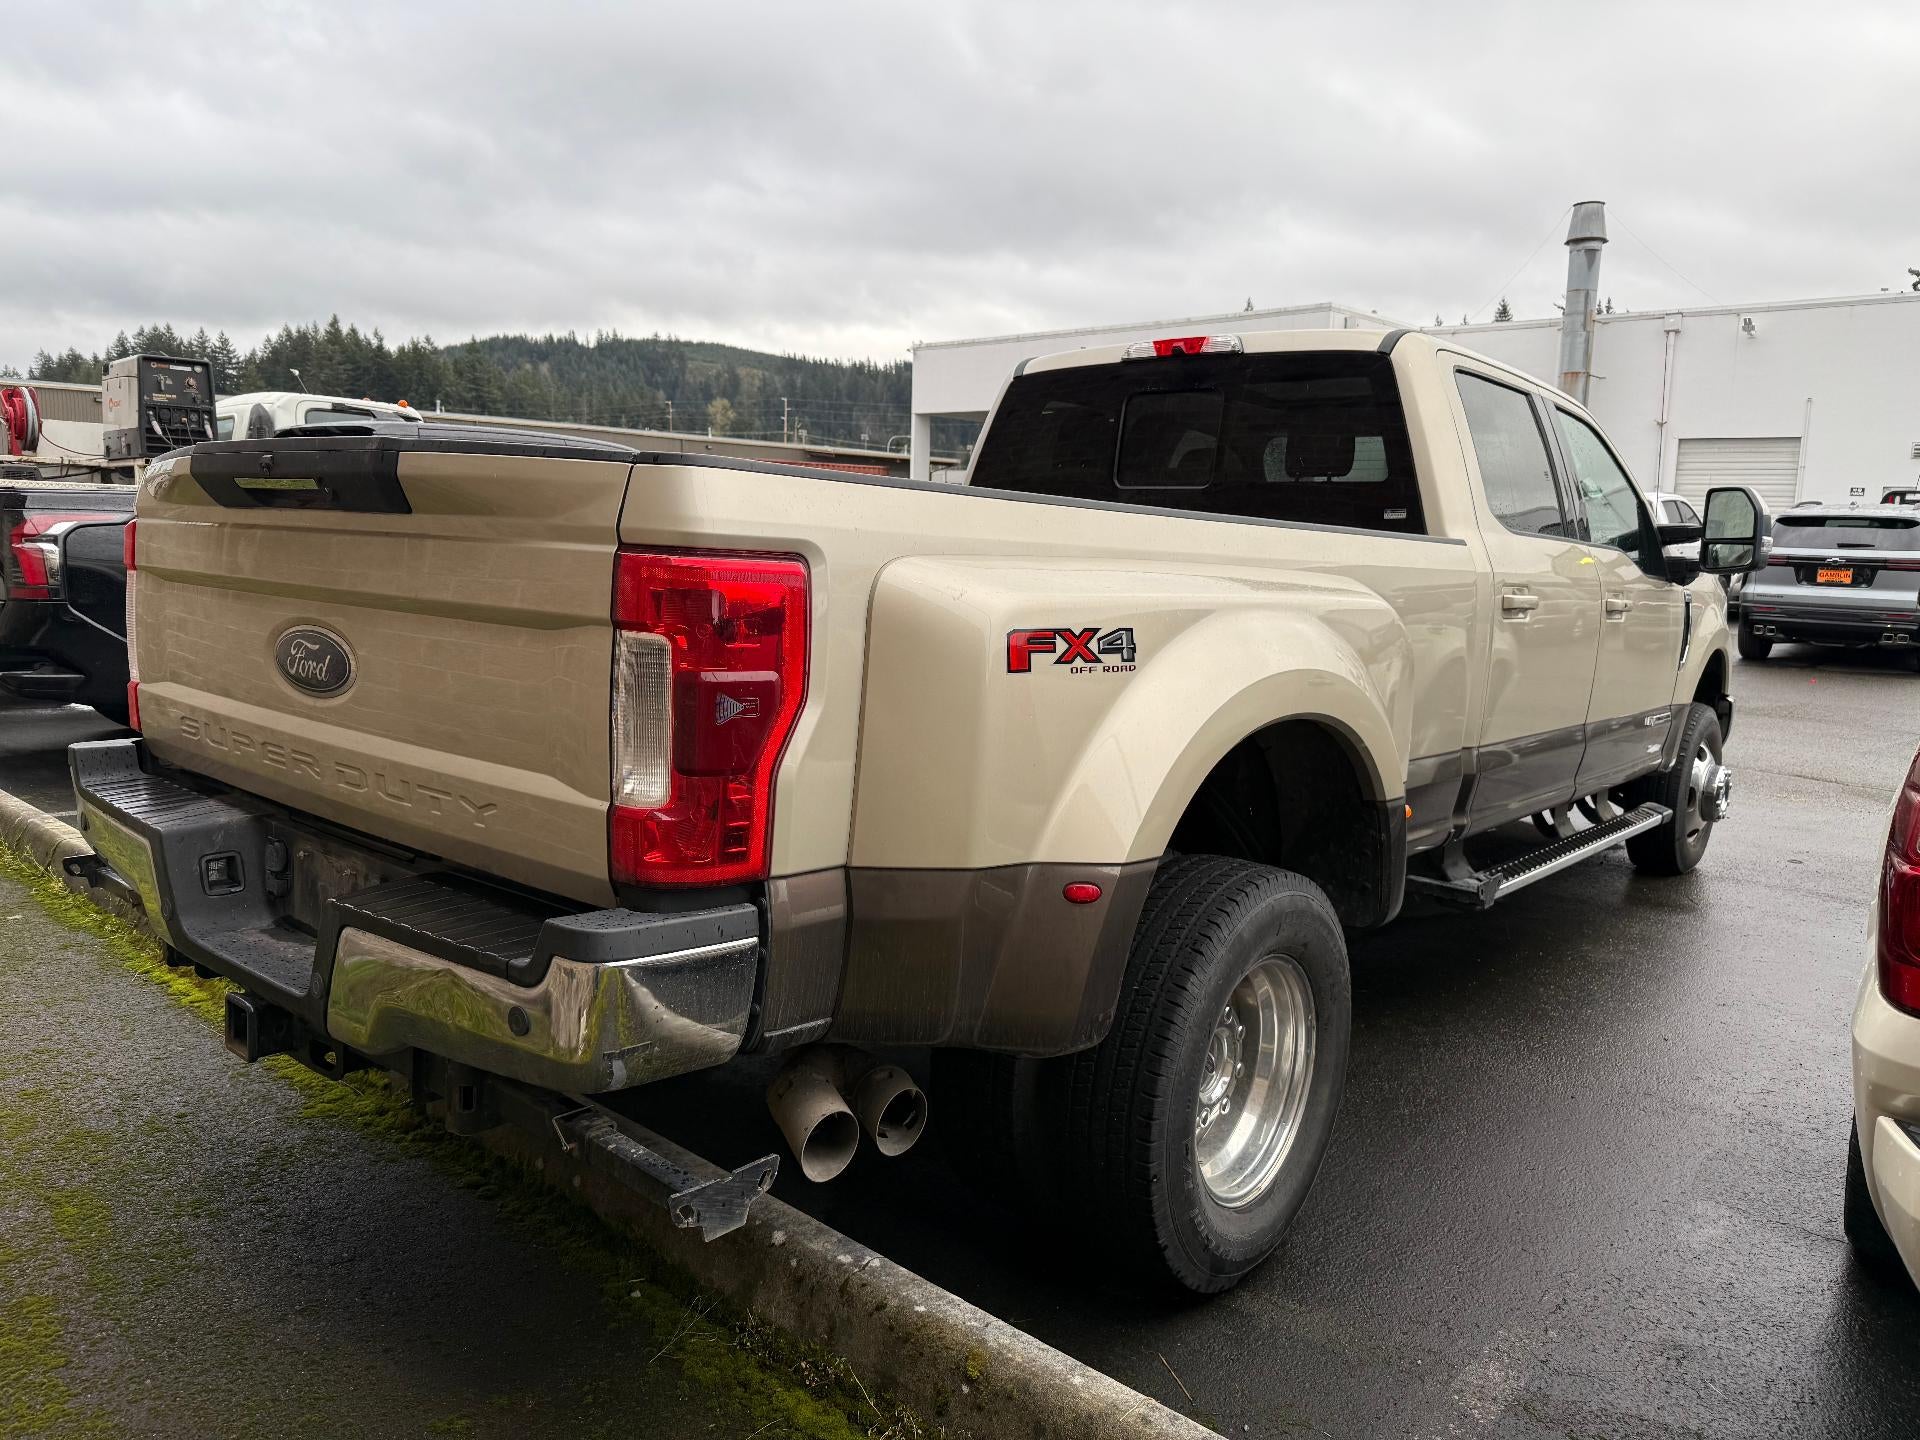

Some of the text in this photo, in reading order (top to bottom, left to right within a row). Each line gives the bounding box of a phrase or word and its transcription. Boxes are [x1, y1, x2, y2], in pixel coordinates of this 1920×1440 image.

[287, 638, 331, 682] Ford
[1007, 627, 1136, 673] FX4
[1070, 664, 1136, 674] OFF ROAD
[179, 714, 497, 828] SUPER DUTY
